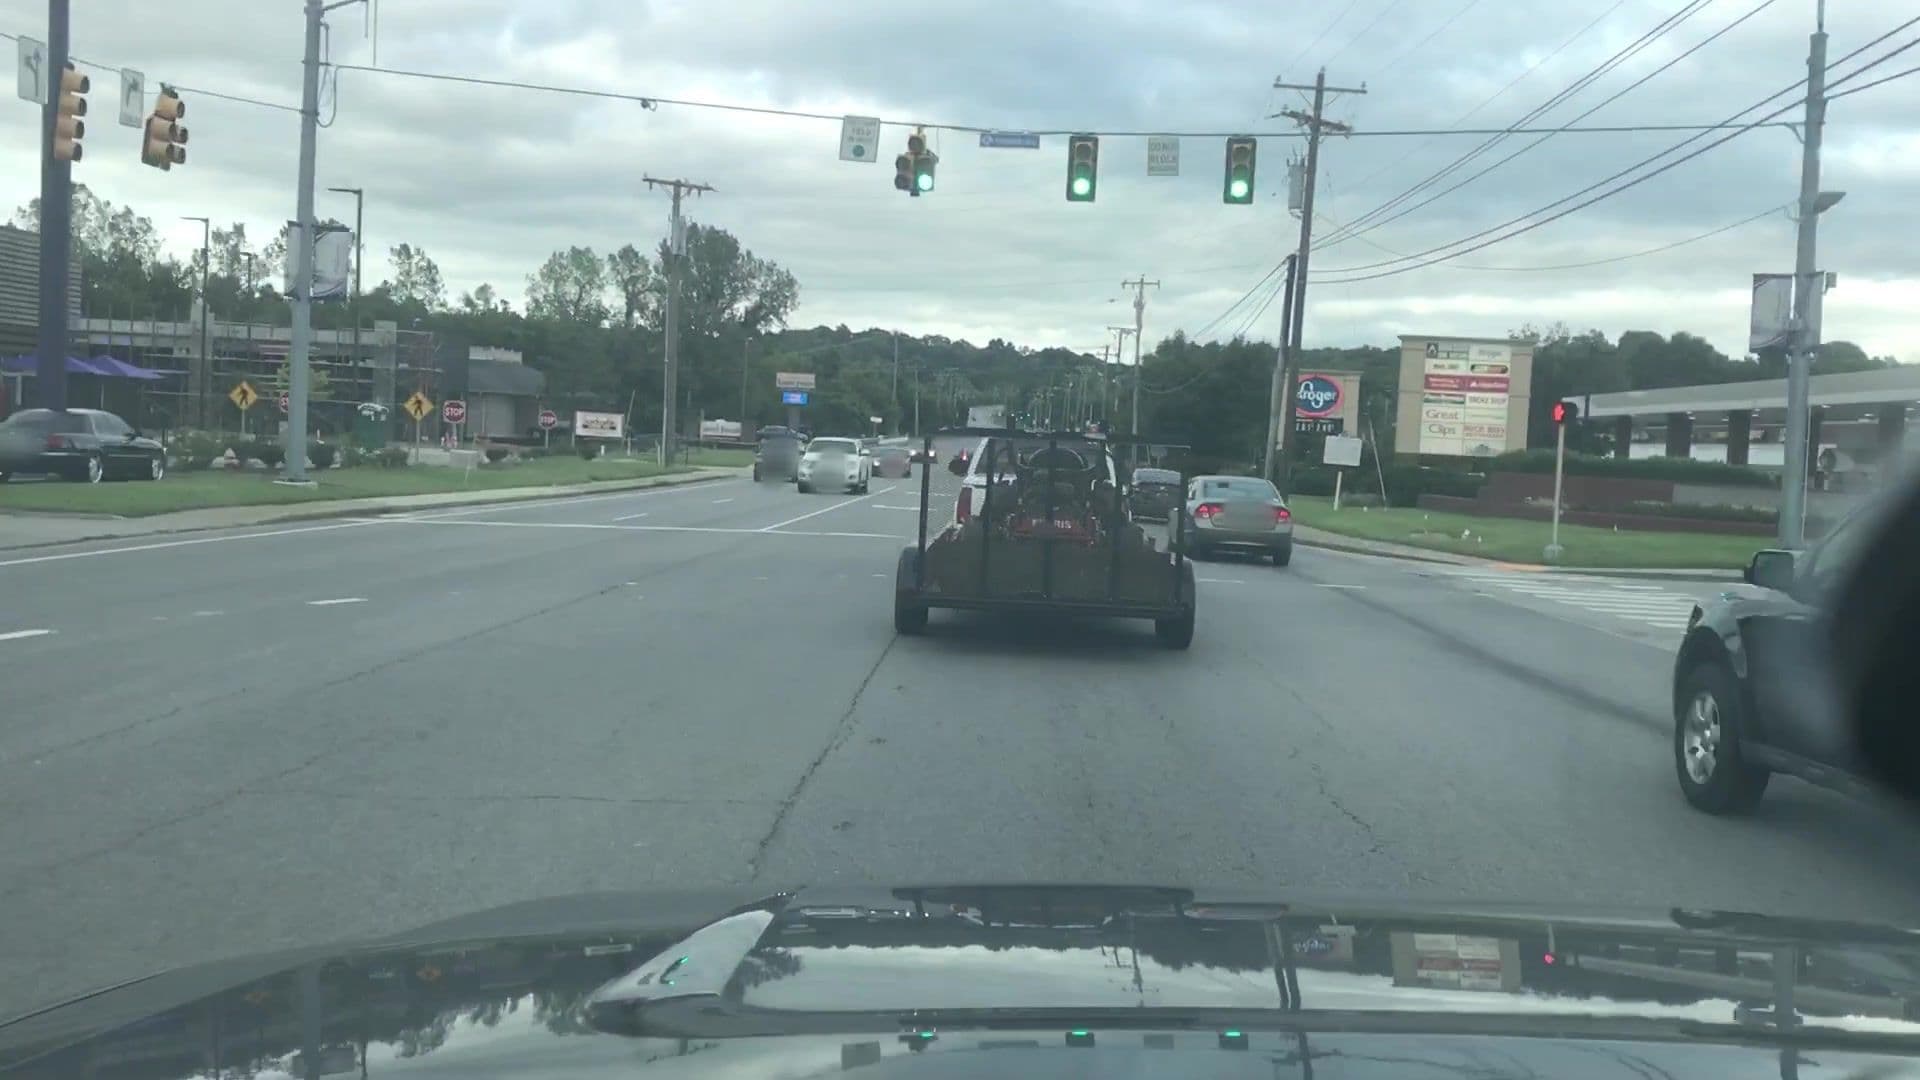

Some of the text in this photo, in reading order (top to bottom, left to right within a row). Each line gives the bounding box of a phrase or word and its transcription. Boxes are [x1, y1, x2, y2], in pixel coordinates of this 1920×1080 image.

[1297, 381, 1337, 409] Kroger
[445, 407, 464, 416] STOP
[1426, 408, 1459, 420] Great
[1429, 423, 1456, 436] Clips
